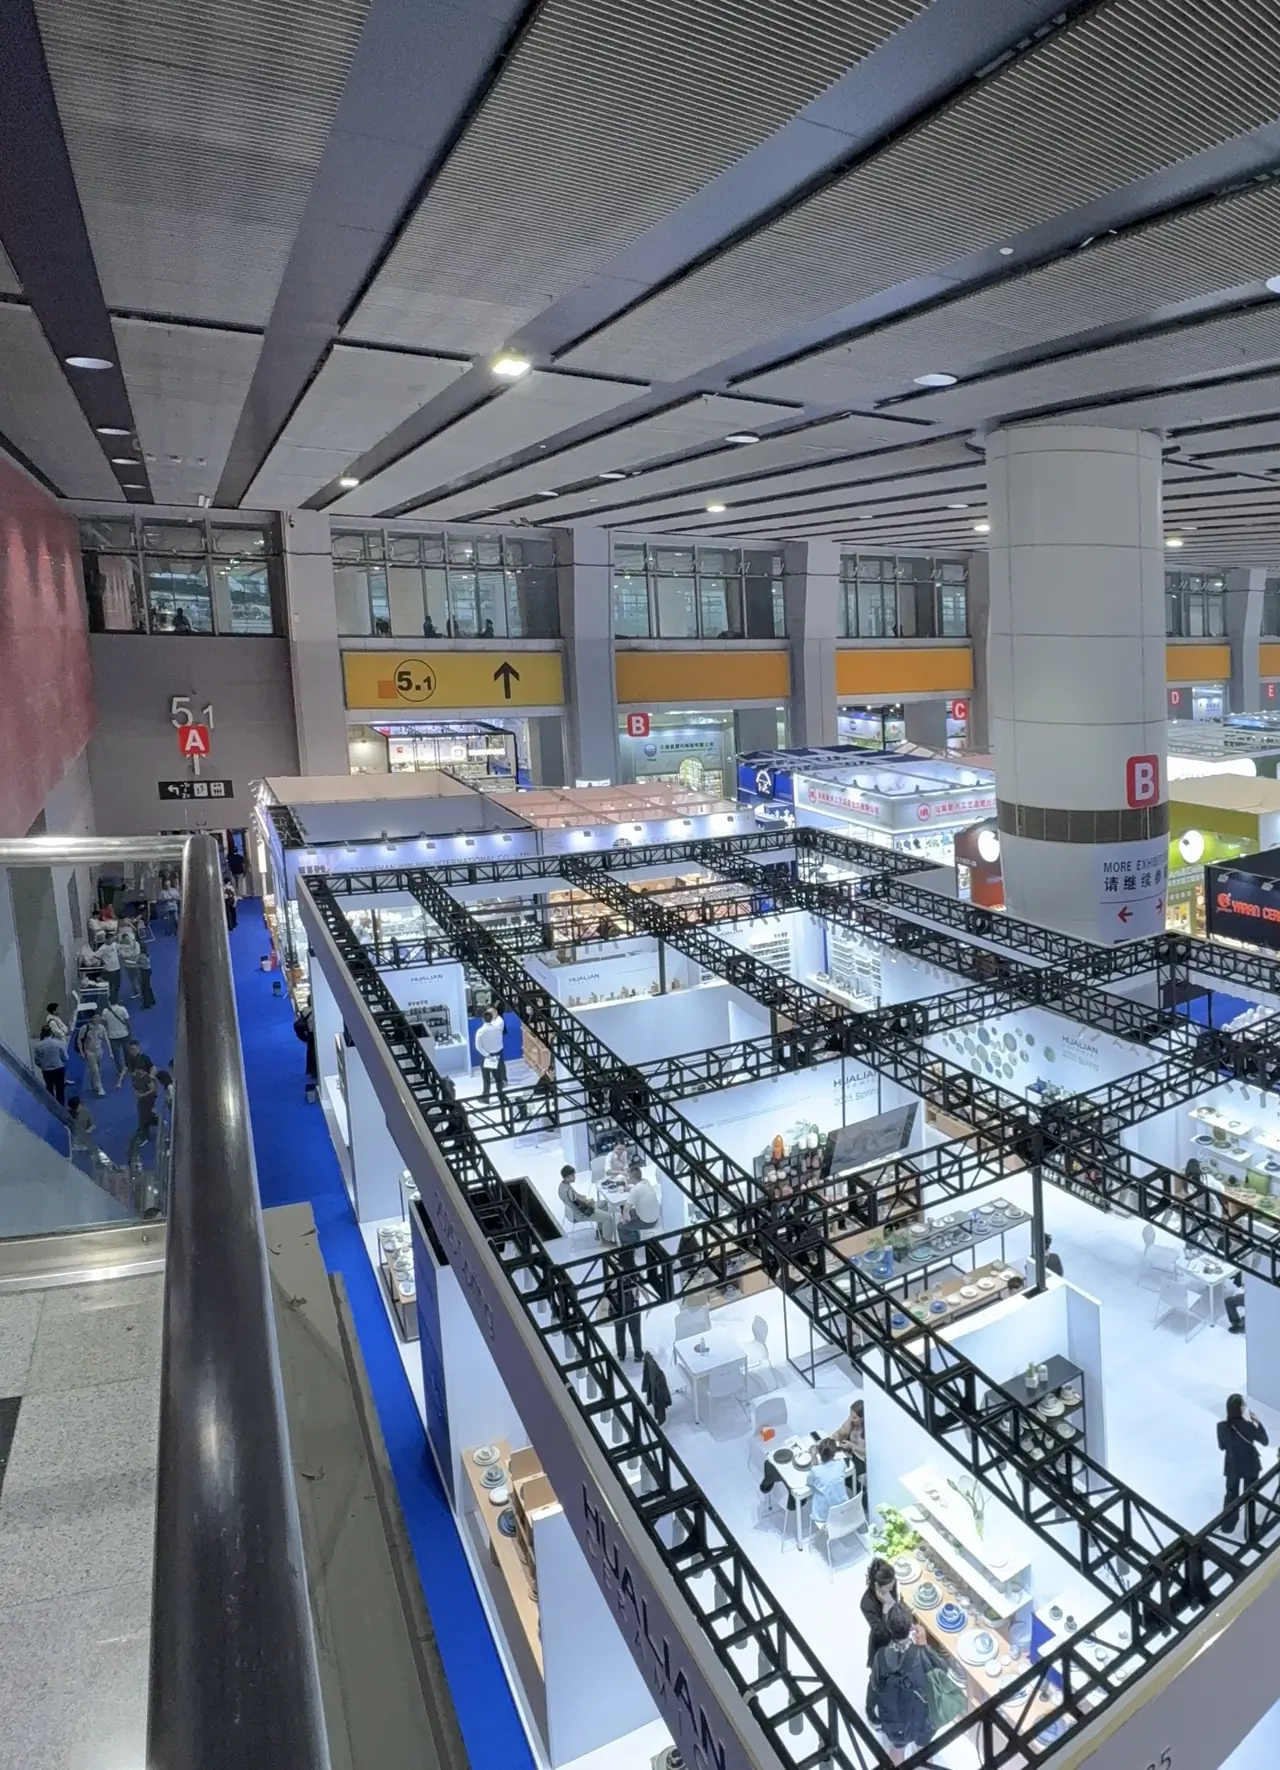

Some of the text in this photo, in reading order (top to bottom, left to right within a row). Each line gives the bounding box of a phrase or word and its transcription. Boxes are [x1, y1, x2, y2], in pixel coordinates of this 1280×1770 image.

[397, 671, 432, 691] 5.1
[1171, 691, 1180, 704] D
[1268, 685, 1275, 697] E
[955, 703, 965, 718] C
[631, 716, 645, 735] B
[185, 729, 206, 751] A
[1134, 762, 1155, 801] B
[1103, 860, 1132, 873] MORE
[410, 973, 444, 983] HUALIAN
[568, 973, 601, 984] HUALIAN
[1062, 1035, 1099, 1054] HUALIAN
[582, 1480, 727, 1770] HUALIAN
